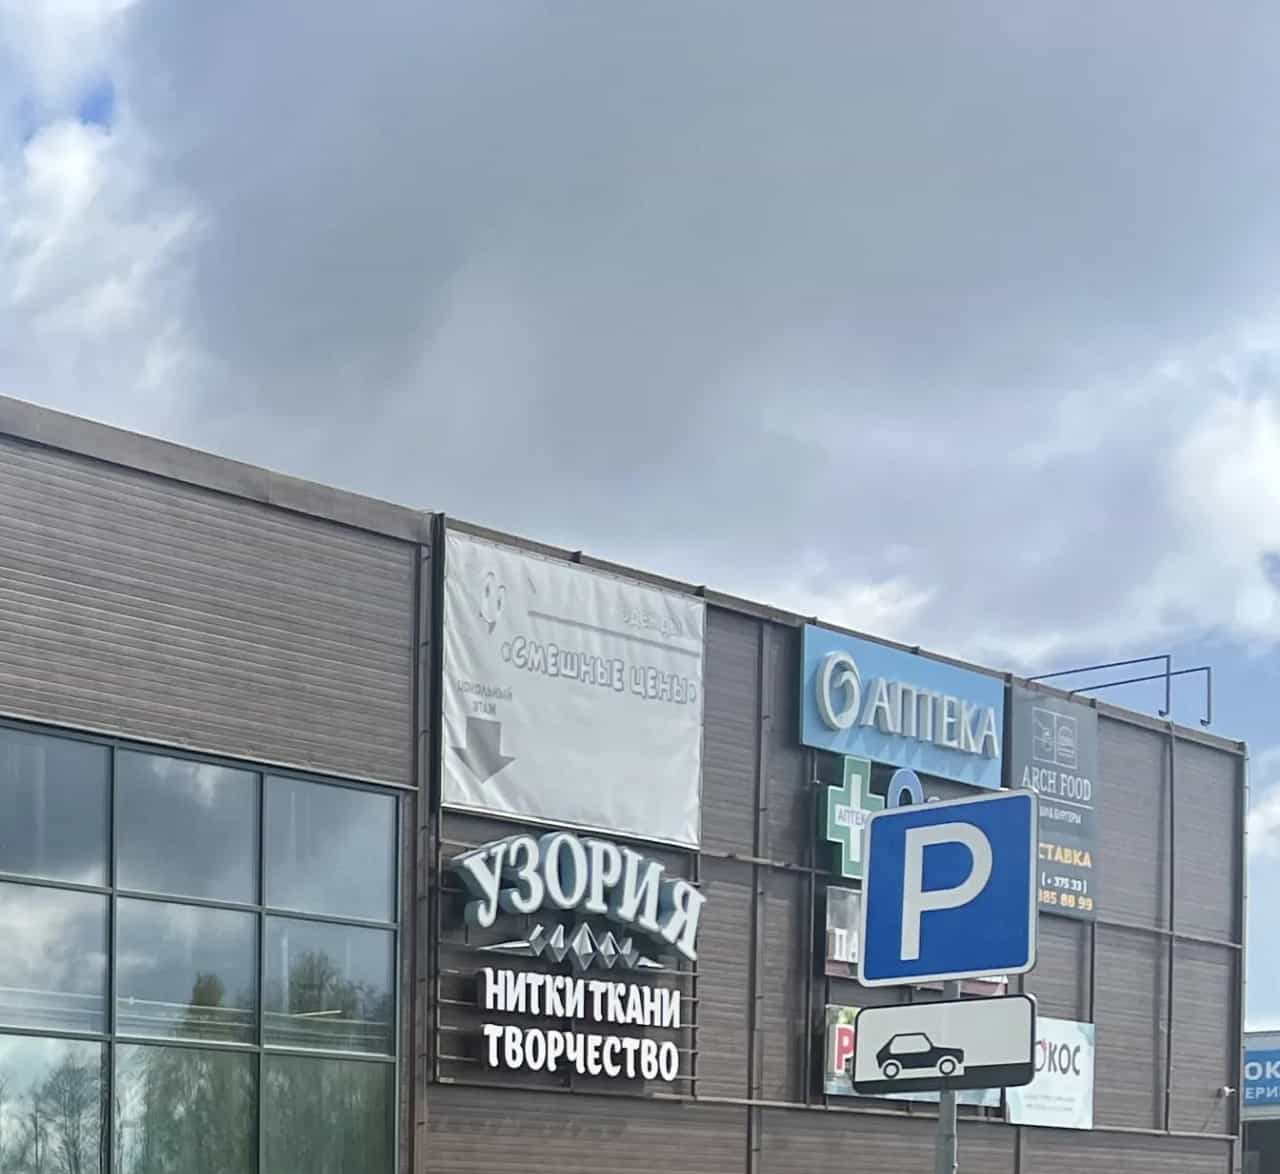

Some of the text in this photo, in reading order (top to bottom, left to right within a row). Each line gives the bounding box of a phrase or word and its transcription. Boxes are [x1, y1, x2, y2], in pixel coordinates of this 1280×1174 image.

[861, 676, 1000, 759] АПТЕКА
[1021, 764, 1092, 801] ARCH FOOD
[450, 831, 707, 962] УЗОРИЯ
[483, 967, 681, 1029] НИТКИ ТКАНИ
[483, 1023, 680, 1082] ТВОРЧЕСТВО
[1035, 1040, 1081, 1077] ОКОС
